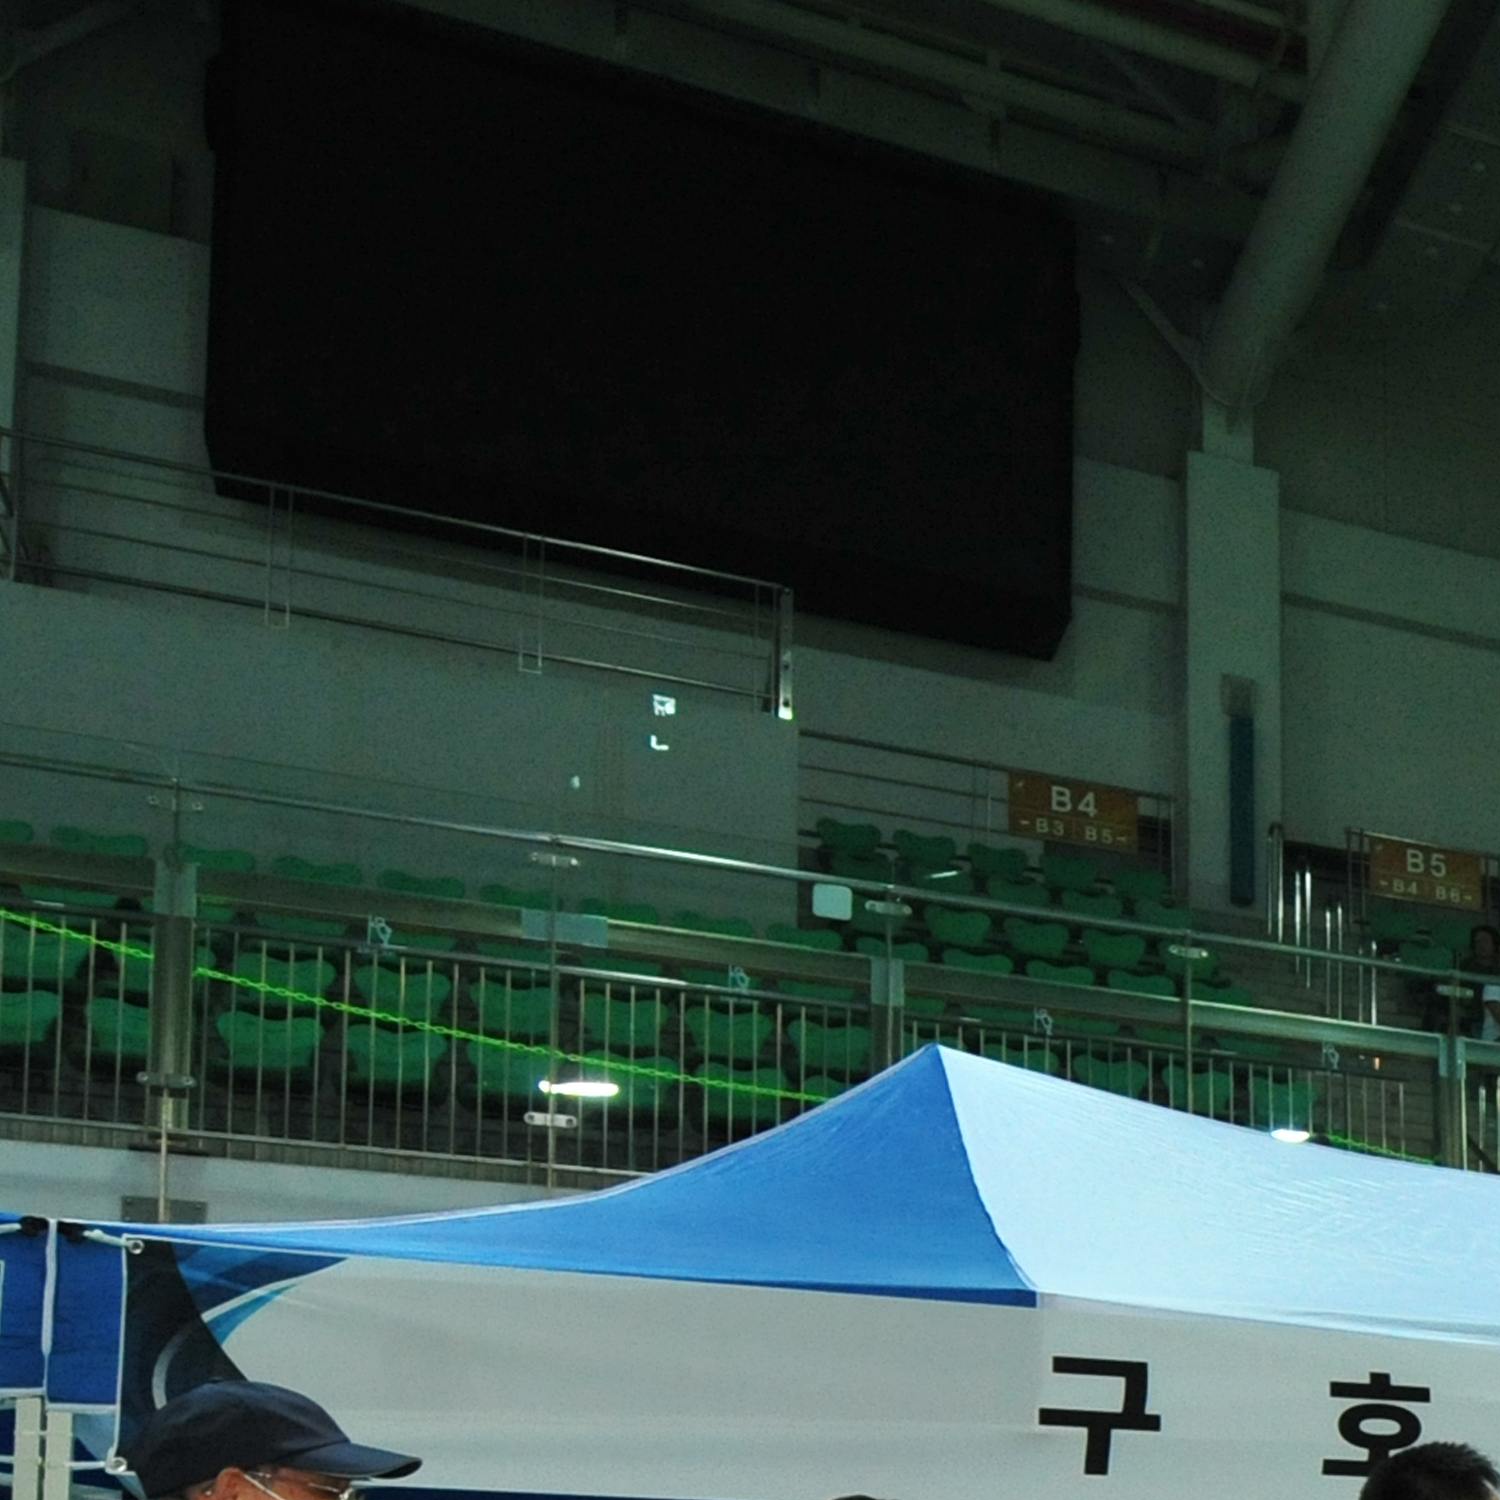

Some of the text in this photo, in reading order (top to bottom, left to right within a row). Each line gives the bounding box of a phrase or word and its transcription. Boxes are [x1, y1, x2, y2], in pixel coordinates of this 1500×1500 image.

[1051, 785, 1099, 817] B4
[1035, 818, 1113, 843] B3 B5
[1405, 848, 1447, 877] B5
